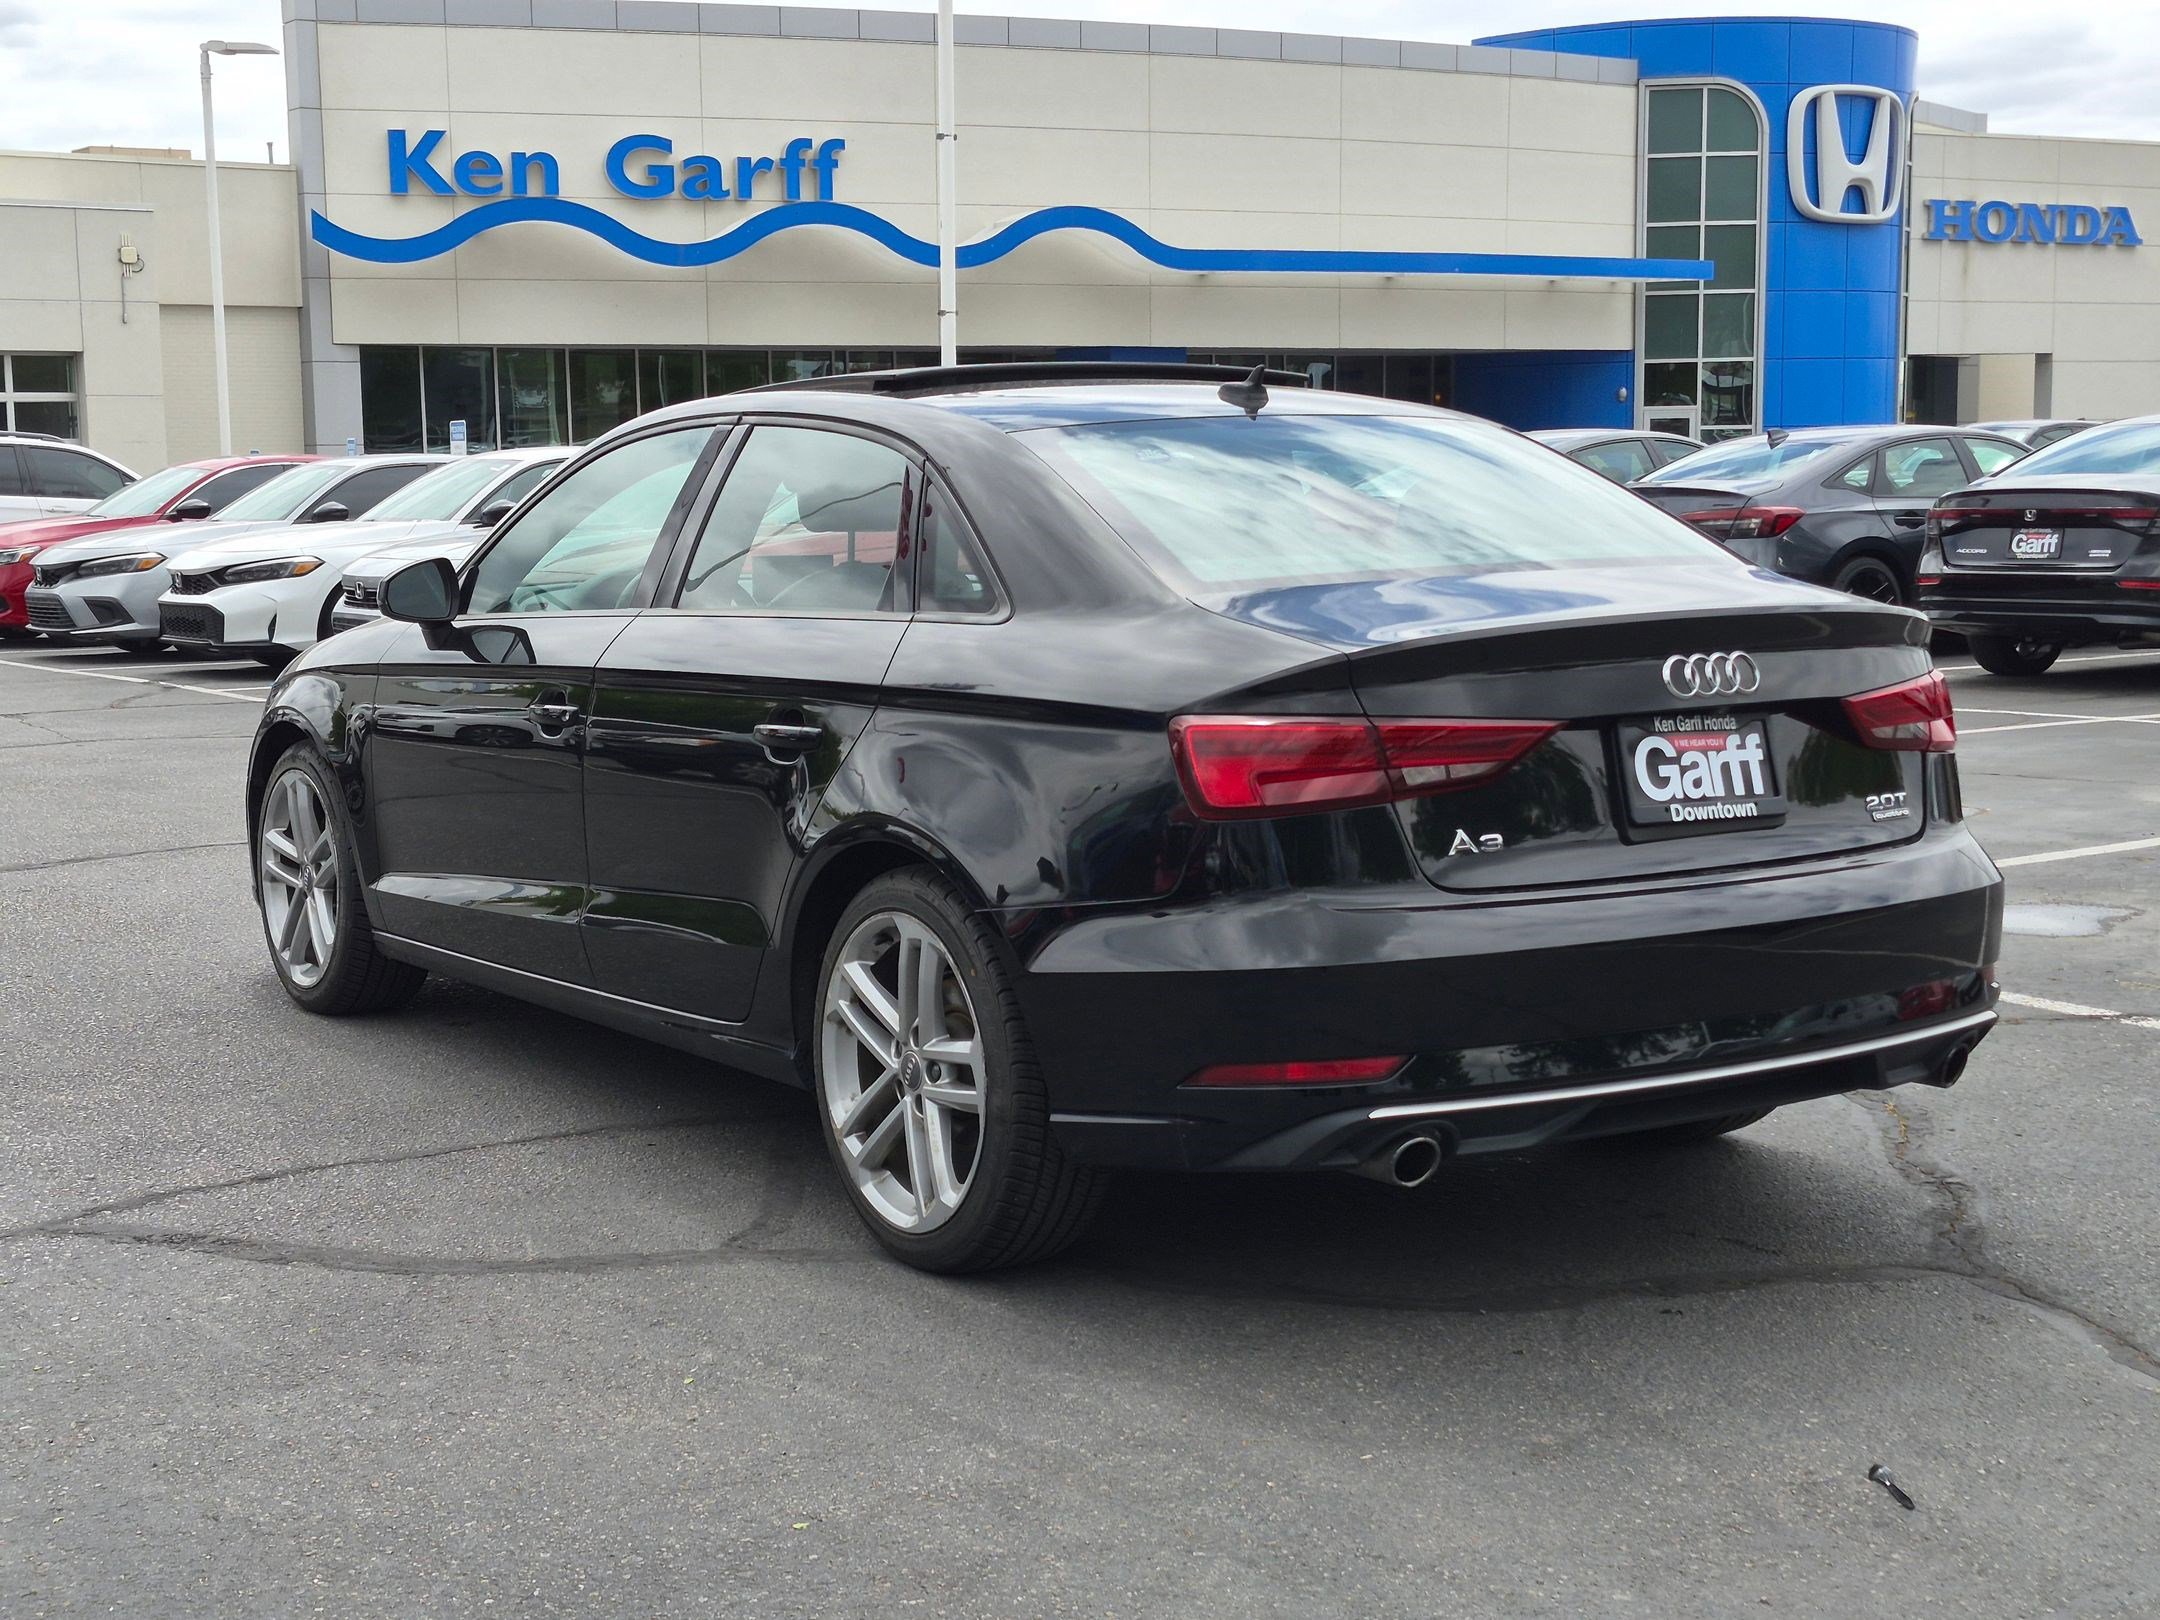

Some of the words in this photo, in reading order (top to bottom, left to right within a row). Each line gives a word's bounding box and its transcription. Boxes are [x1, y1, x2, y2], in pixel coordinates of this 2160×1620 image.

[386, 128, 560, 198] Ken
[604, 133, 846, 201] Garff
[1922, 198, 2144, 247] HONDA
[2011, 533, 2058, 553] Garff
[1653, 715, 1676, 733] Ken
[1676, 714, 1702, 732] Garff
[1703, 713, 1737, 730] Honda
[1678, 738, 1689, 747] WE
[1689, 738, 1706, 747] HEAR
[1706, 737, 1719, 746] YOU
[1634, 733, 1764, 802] Garff
[1669, 802, 1758, 822] Downtown
[1447, 828, 1504, 856] A3
